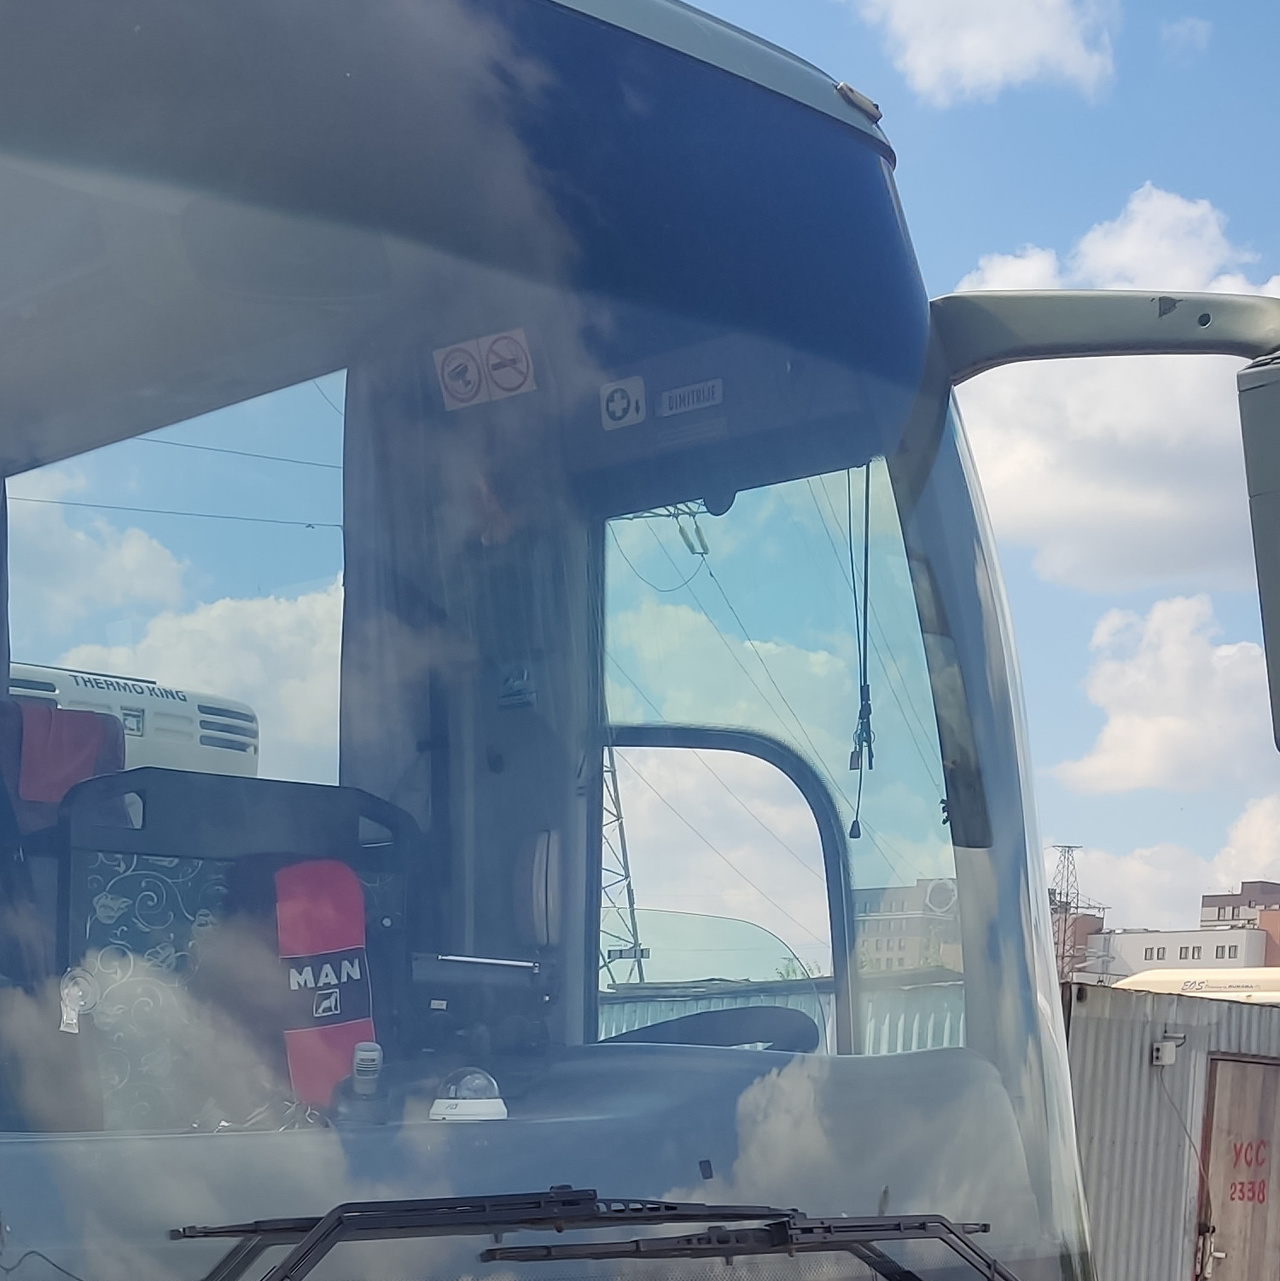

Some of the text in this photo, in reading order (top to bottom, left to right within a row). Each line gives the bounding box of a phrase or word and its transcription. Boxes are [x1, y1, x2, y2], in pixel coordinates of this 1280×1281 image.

[69, 675, 187, 702] THERMO KING
[289, 958, 361, 990] MAN
[1230, 1180, 1266, 1205] 2338
